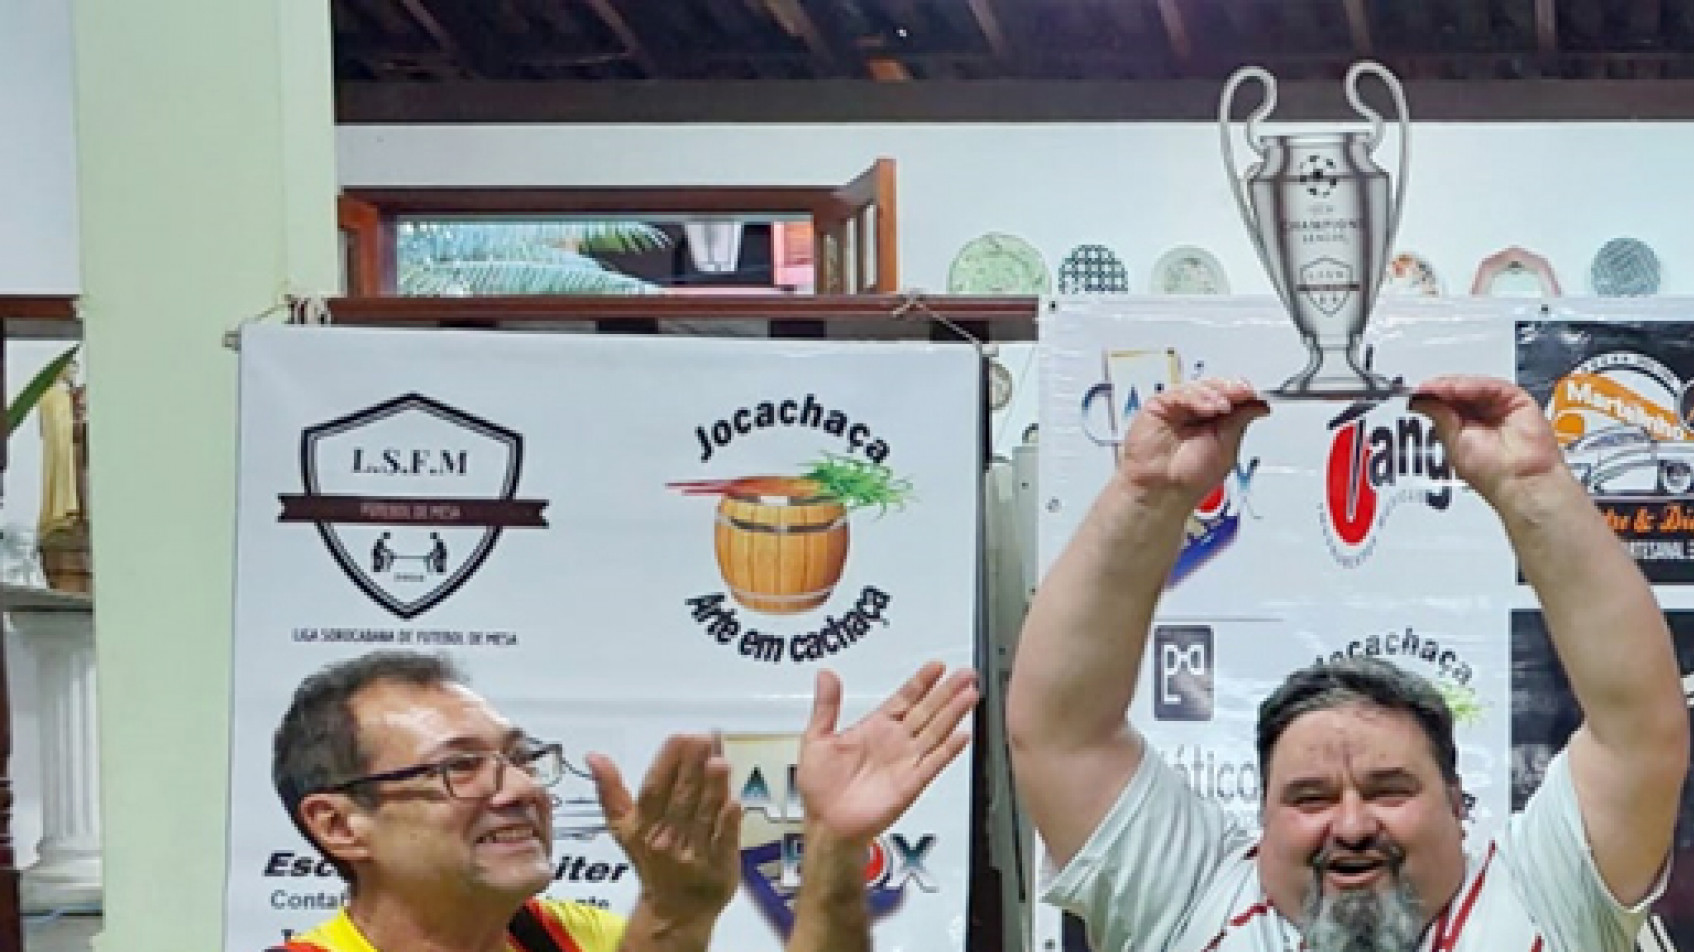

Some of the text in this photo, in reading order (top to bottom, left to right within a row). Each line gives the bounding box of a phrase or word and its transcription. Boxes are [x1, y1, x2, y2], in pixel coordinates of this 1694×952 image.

[695, 393, 891, 463] Jocachaça
[685, 584, 891, 662] Arte em cachaça
